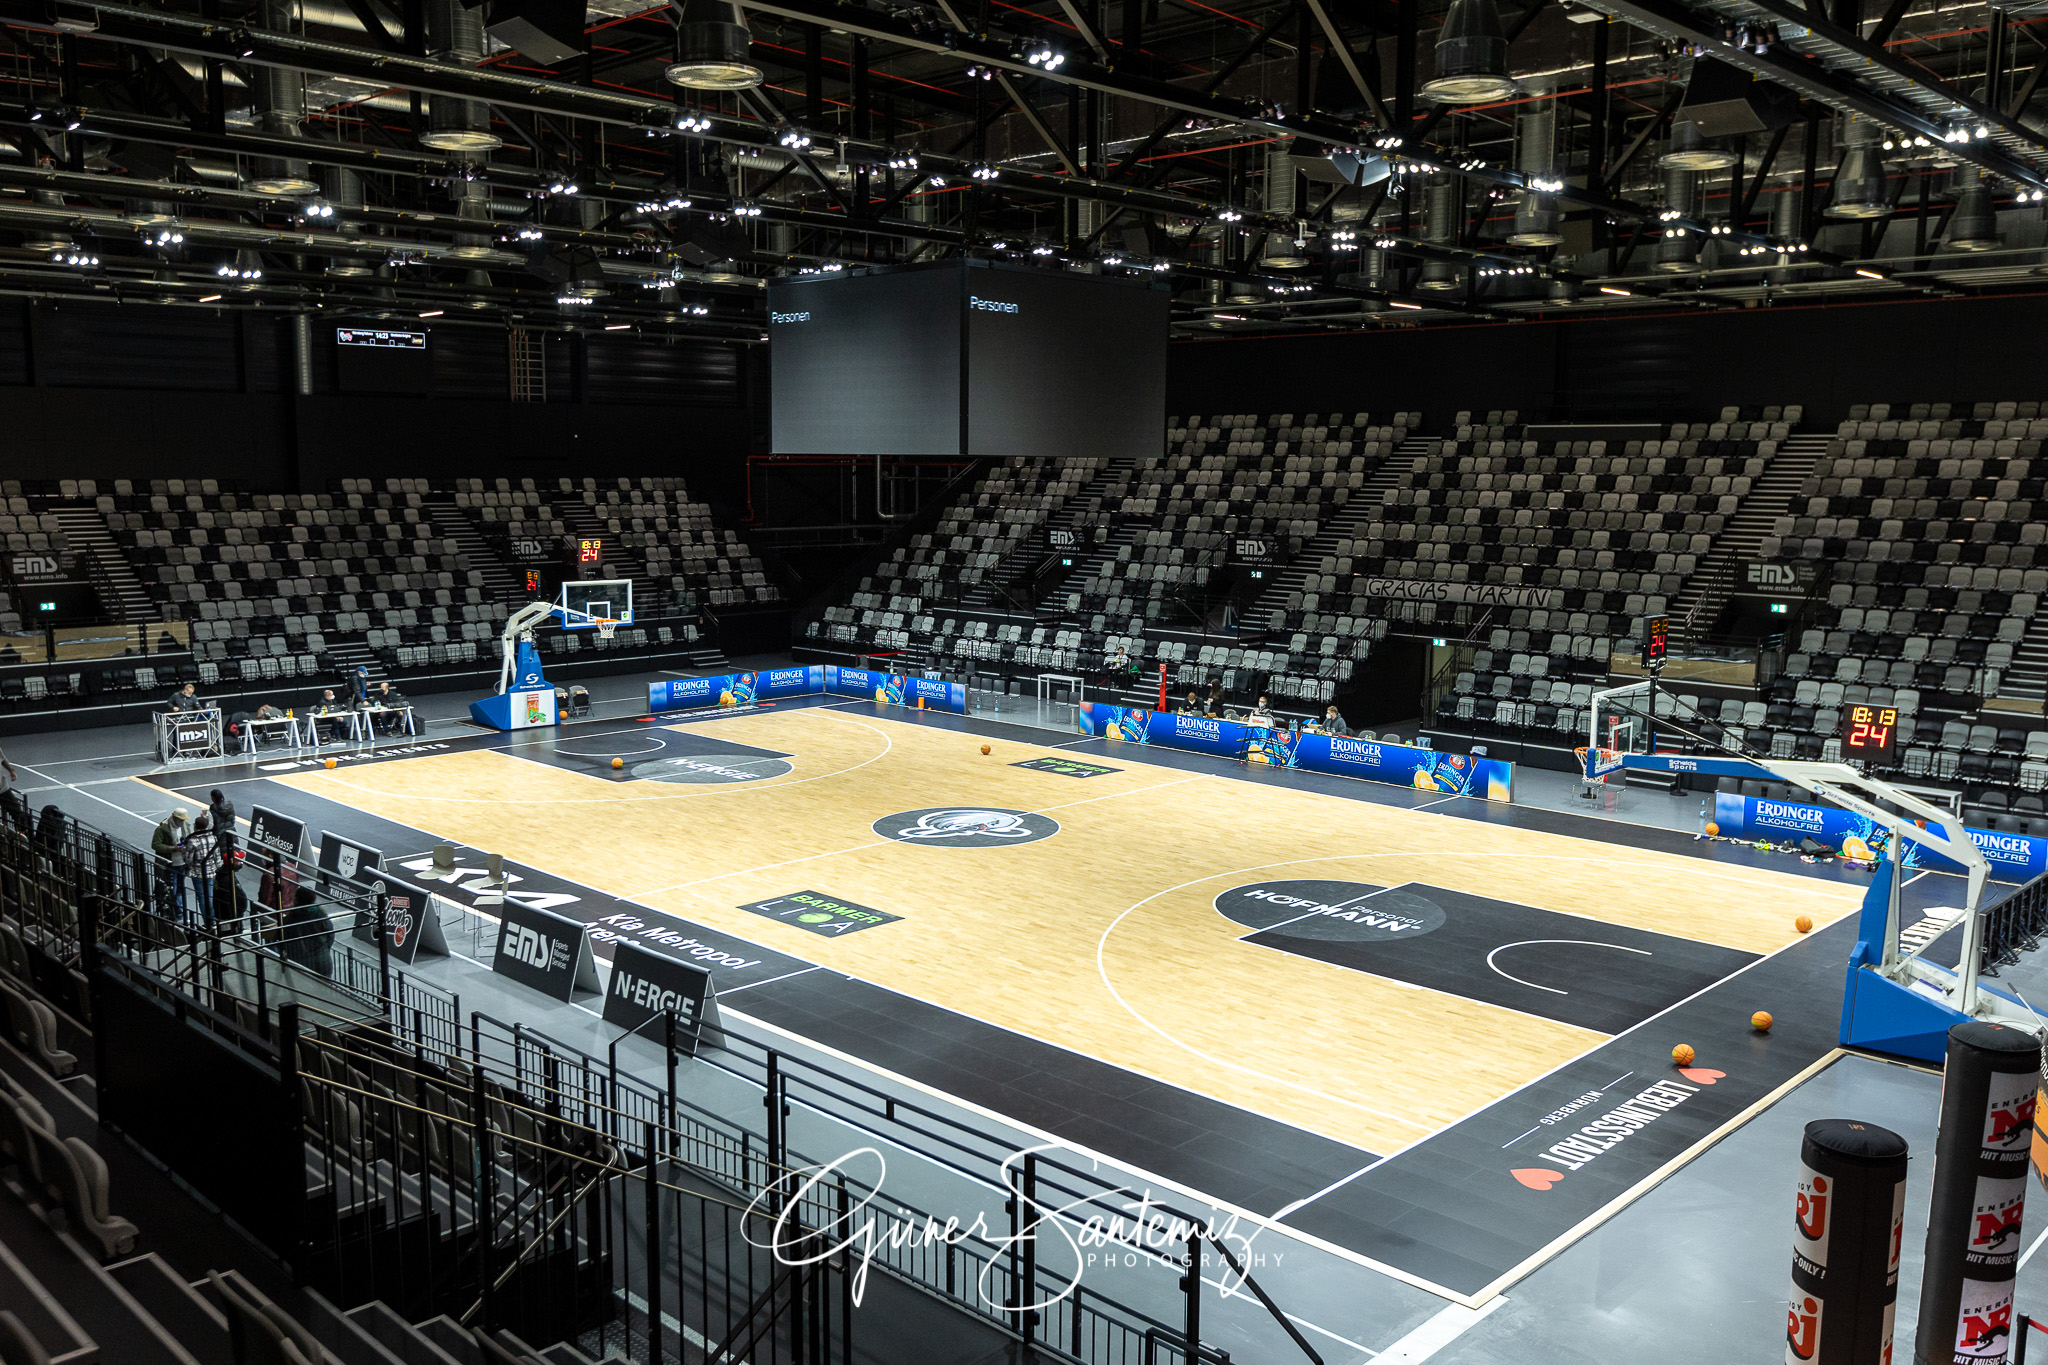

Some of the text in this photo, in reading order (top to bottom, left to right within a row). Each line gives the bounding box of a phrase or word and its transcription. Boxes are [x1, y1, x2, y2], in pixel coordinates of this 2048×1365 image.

[970, 295, 1019, 314] Personen
[771, 310, 811, 324] Personen
[581, 548, 599, 562] 24
[1236, 540, 1266, 556] EMS
[12, 556, 58, 575] EMS
[1747, 564, 1795, 585] EMS
[24, 573, 68, 581] www.ems.info
[526, 580, 537, 591] 24
[1368, 579, 1548, 607] GRACIAS MARTIN
[1757, 585, 1805, 593] www.ems.info
[1650, 634, 1666, 656] 24
[770, 669, 803, 682] ERDINGER
[841, 668, 869, 682] ERDINGER
[673, 679, 710, 692] ERDINGER
[673, 688, 710, 698] ALKOHOLFREI
[916, 679, 946, 694] ERDINGER
[1176, 715, 1220, 734] ERDINGER
[1852, 706, 1897, 726] 18:13
[1176, 728, 1220, 740] ALKOHOLFREI
[1850, 723, 1888, 749] 24
[1330, 737, 1382, 758] ERDINGER
[1330, 751, 1381, 765] ALKOHOLFREI
[1437, 762, 1465, 786] ERDINGER
[1756, 800, 1824, 825] ERDINGER
[1755, 815, 1823, 831] ALKOHOLFREI
[264, 831, 294, 853] Sparkasse
[789, 894, 884, 925] BARMER
[1244, 889, 1412, 932] HOFMANN
[502, 921, 549, 969] EMS
[598, 913, 762, 970] Kia Metropol
[1991, 1084, 2038, 1110] ENERG
[1539, 1090, 1604, 1126] NÜRNBERG
[1538, 1079, 1701, 1171] LIEBLINGSSTADT
[1980, 1151, 1999, 1161] HIT
[1976, 1191, 2025, 1213] ENERG
[1798, 1258, 1820, 1276] ONLY
[1966, 1253, 2013, 1265] HIT MUSIC
[1963, 1292, 2013, 1315] ENERG
[1953, 1354, 1971, 1365] HIT
